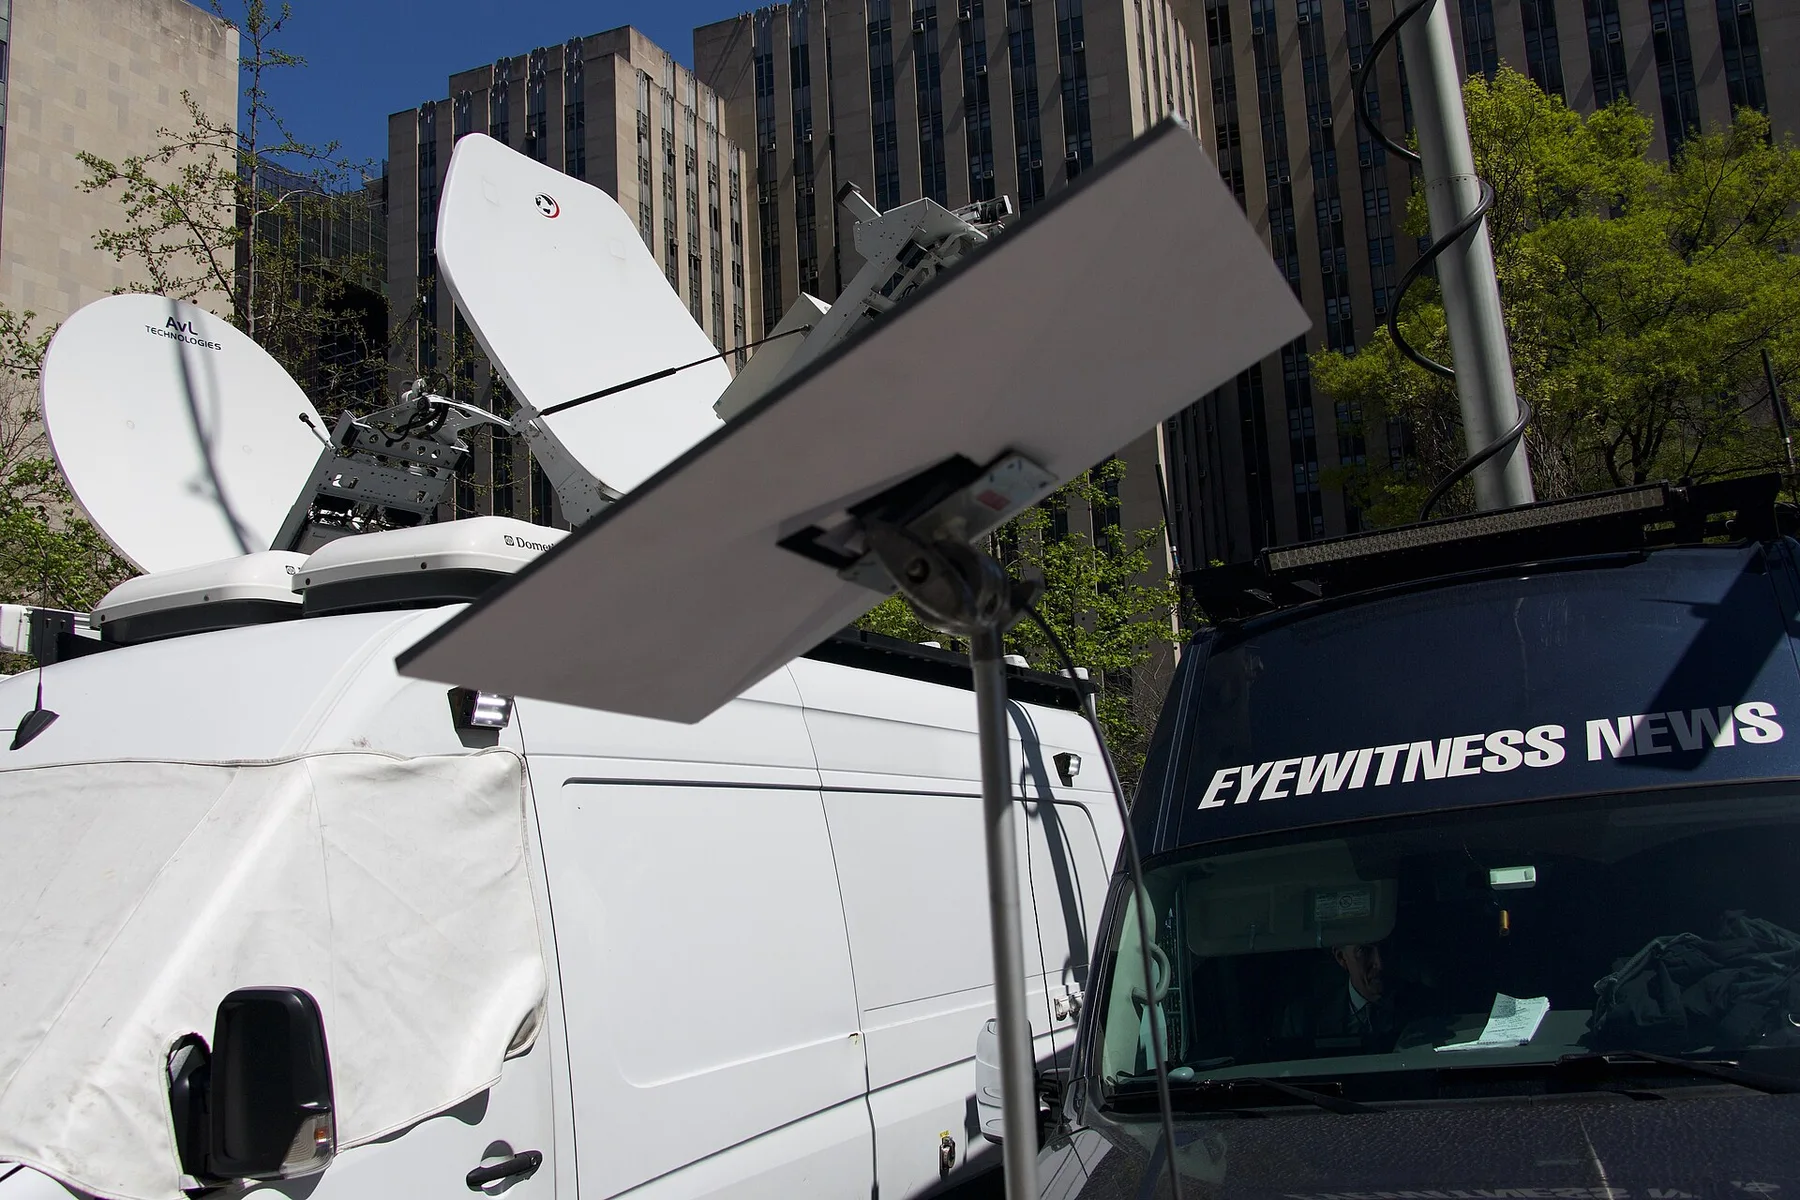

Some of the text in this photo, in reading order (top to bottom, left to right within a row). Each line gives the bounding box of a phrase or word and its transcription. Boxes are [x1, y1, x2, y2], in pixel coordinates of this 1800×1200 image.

[145, 325, 222, 350] TECHNOLOGIES
[166, 316, 198, 335] AvL
[1198, 701, 1784, 809] EYEWITNESS NEWS
